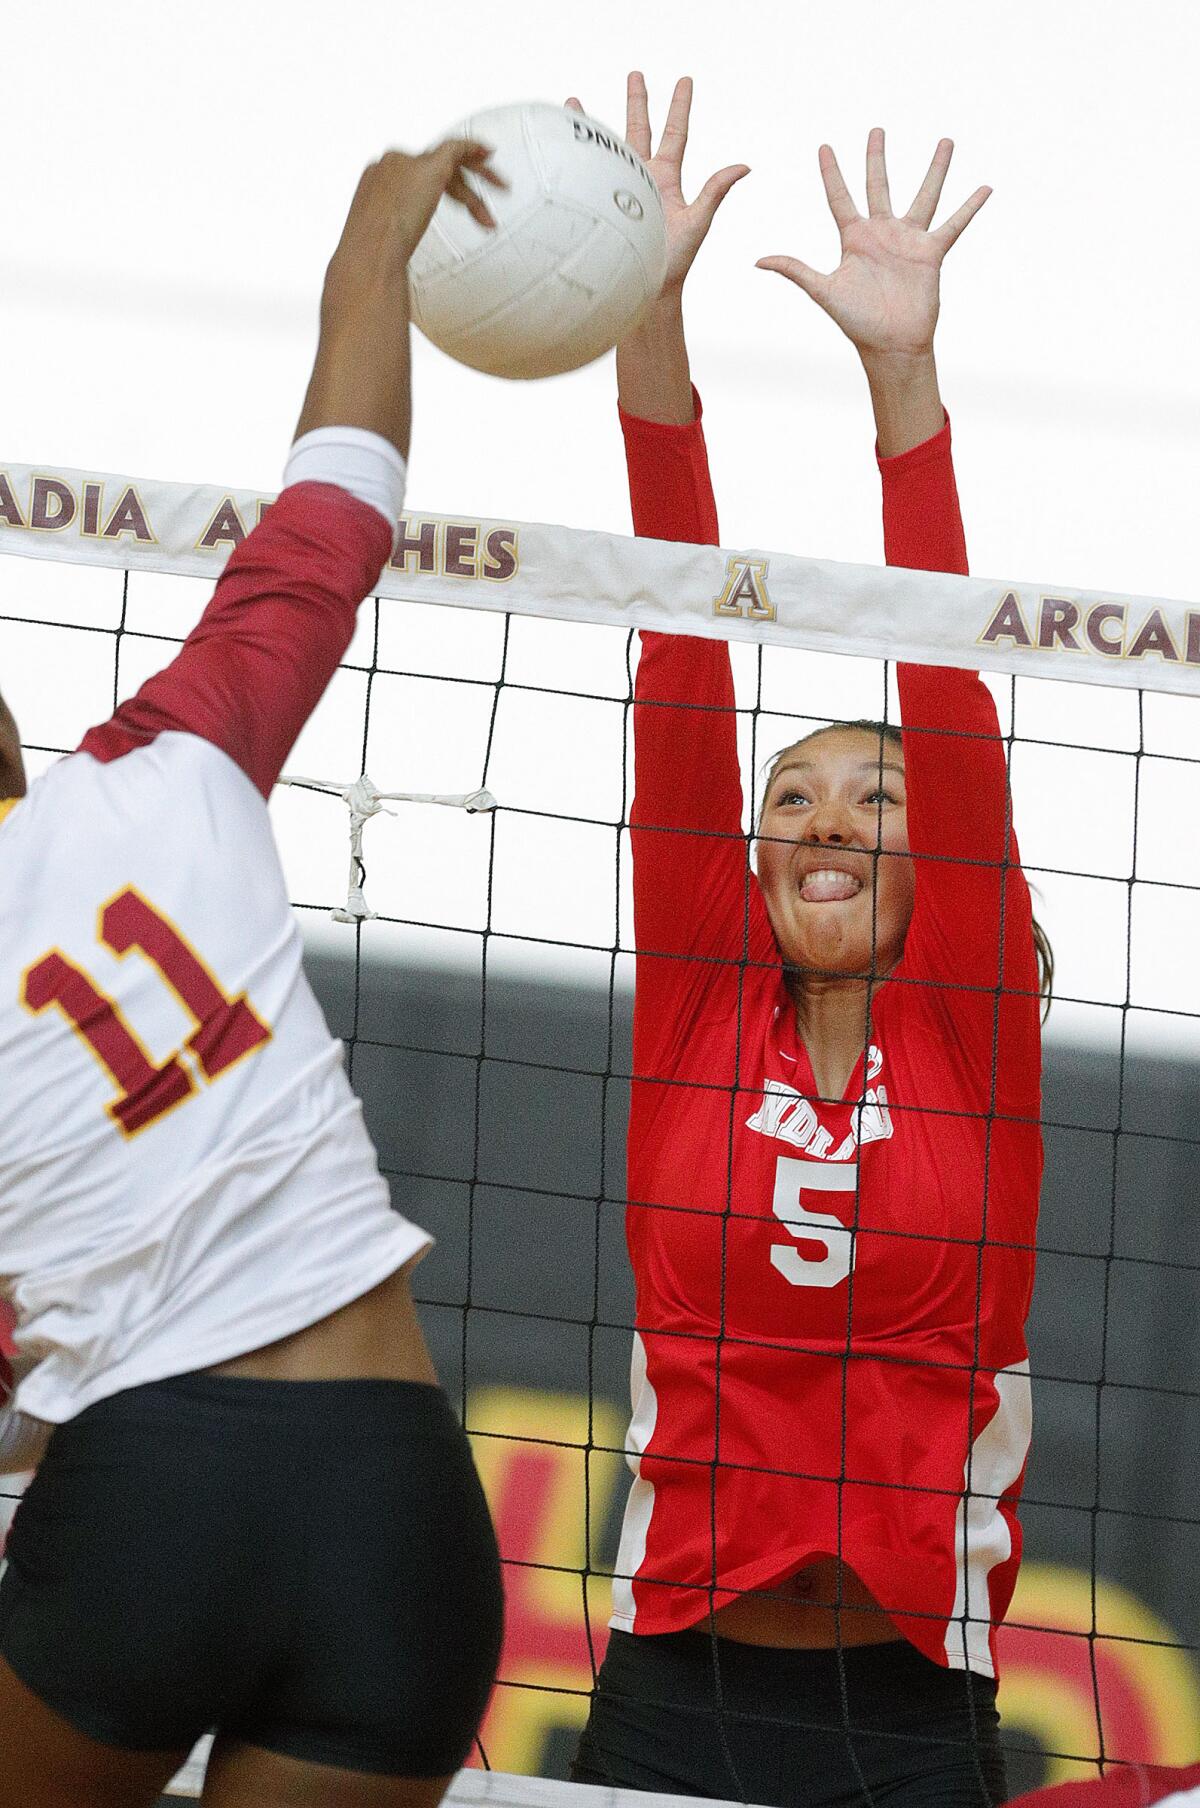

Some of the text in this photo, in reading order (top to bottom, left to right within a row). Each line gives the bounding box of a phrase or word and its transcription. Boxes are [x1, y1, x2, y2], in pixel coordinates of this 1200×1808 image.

[194, 493, 520, 583] AHES
[713, 556, 777, 622] A
[19, 883, 273, 1140] 11
[770, 1156, 858, 1288] 5
